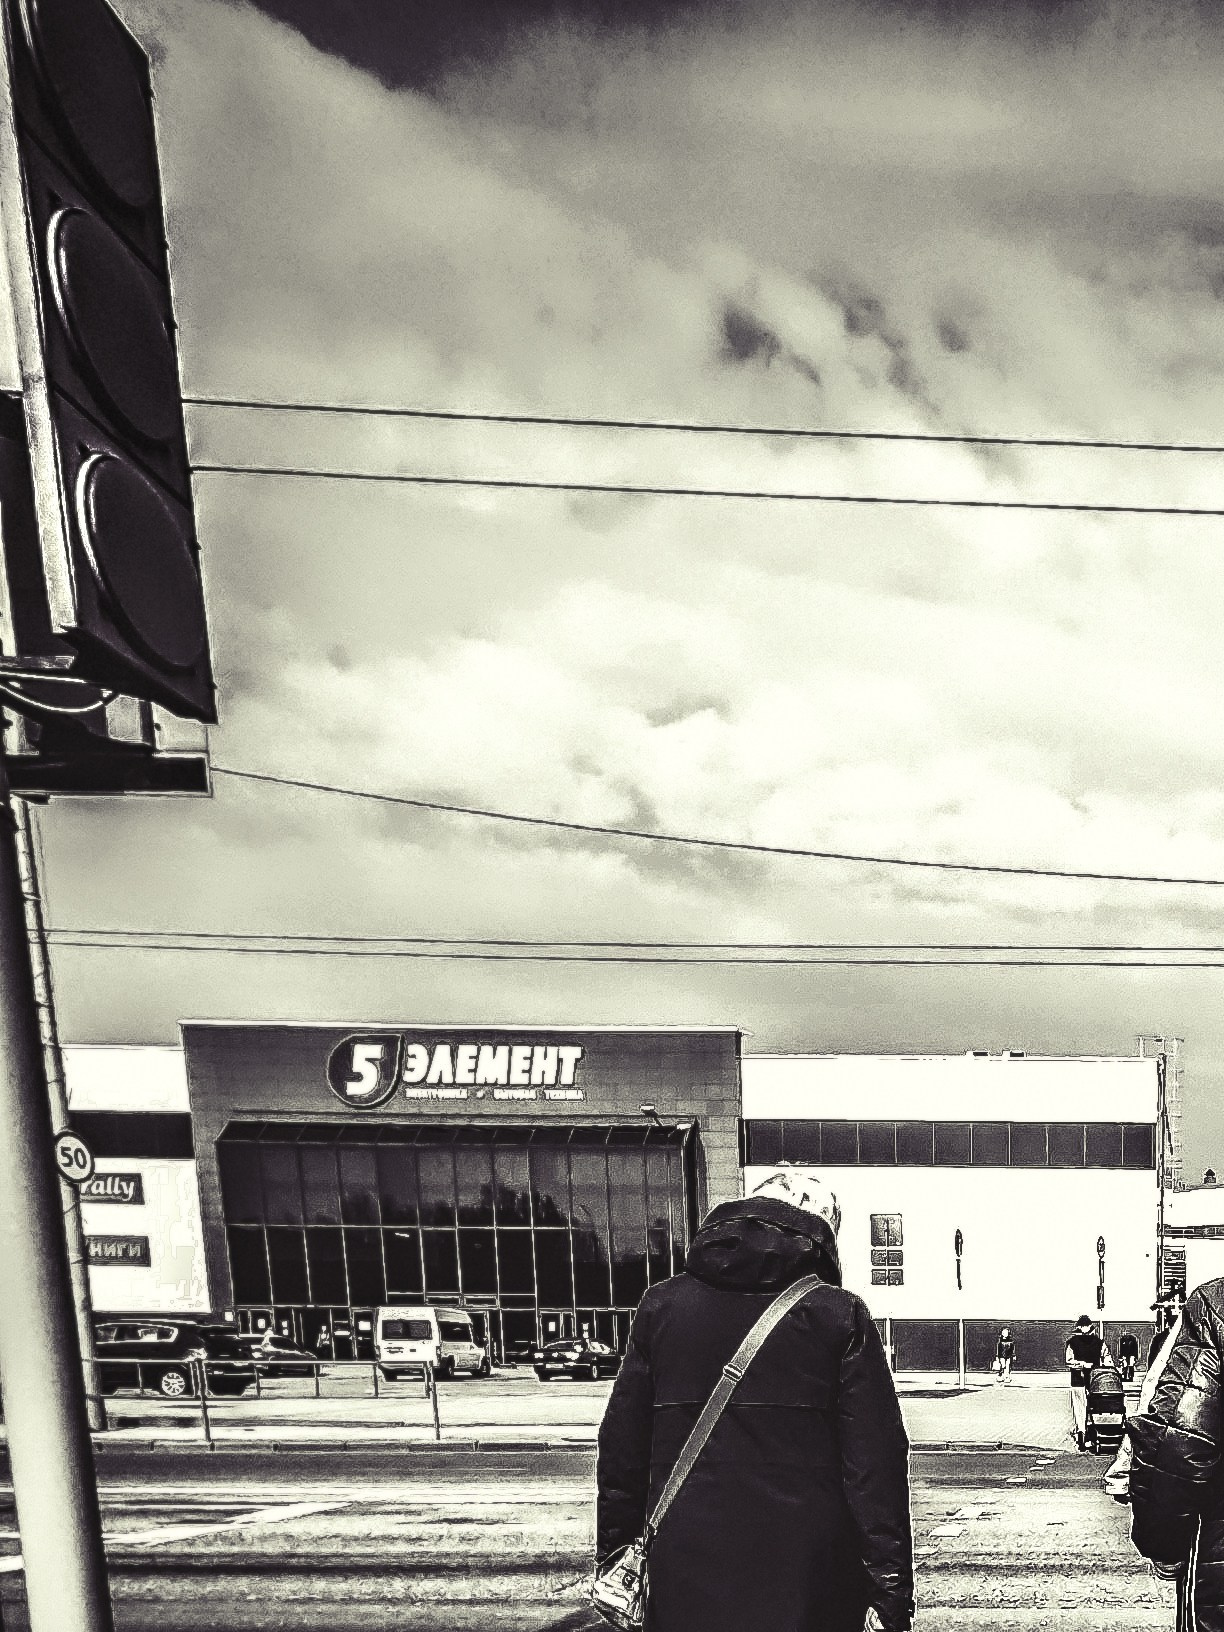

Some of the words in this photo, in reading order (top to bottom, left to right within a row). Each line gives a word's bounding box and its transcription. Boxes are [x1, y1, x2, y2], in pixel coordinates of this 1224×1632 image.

[346, 1043, 384, 1095] 5
[402, 1043, 582, 1085] ЭЛЕМЕНТ
[60, 1146, 87, 1169] 50
[86, 1239, 141, 1257] ниги
